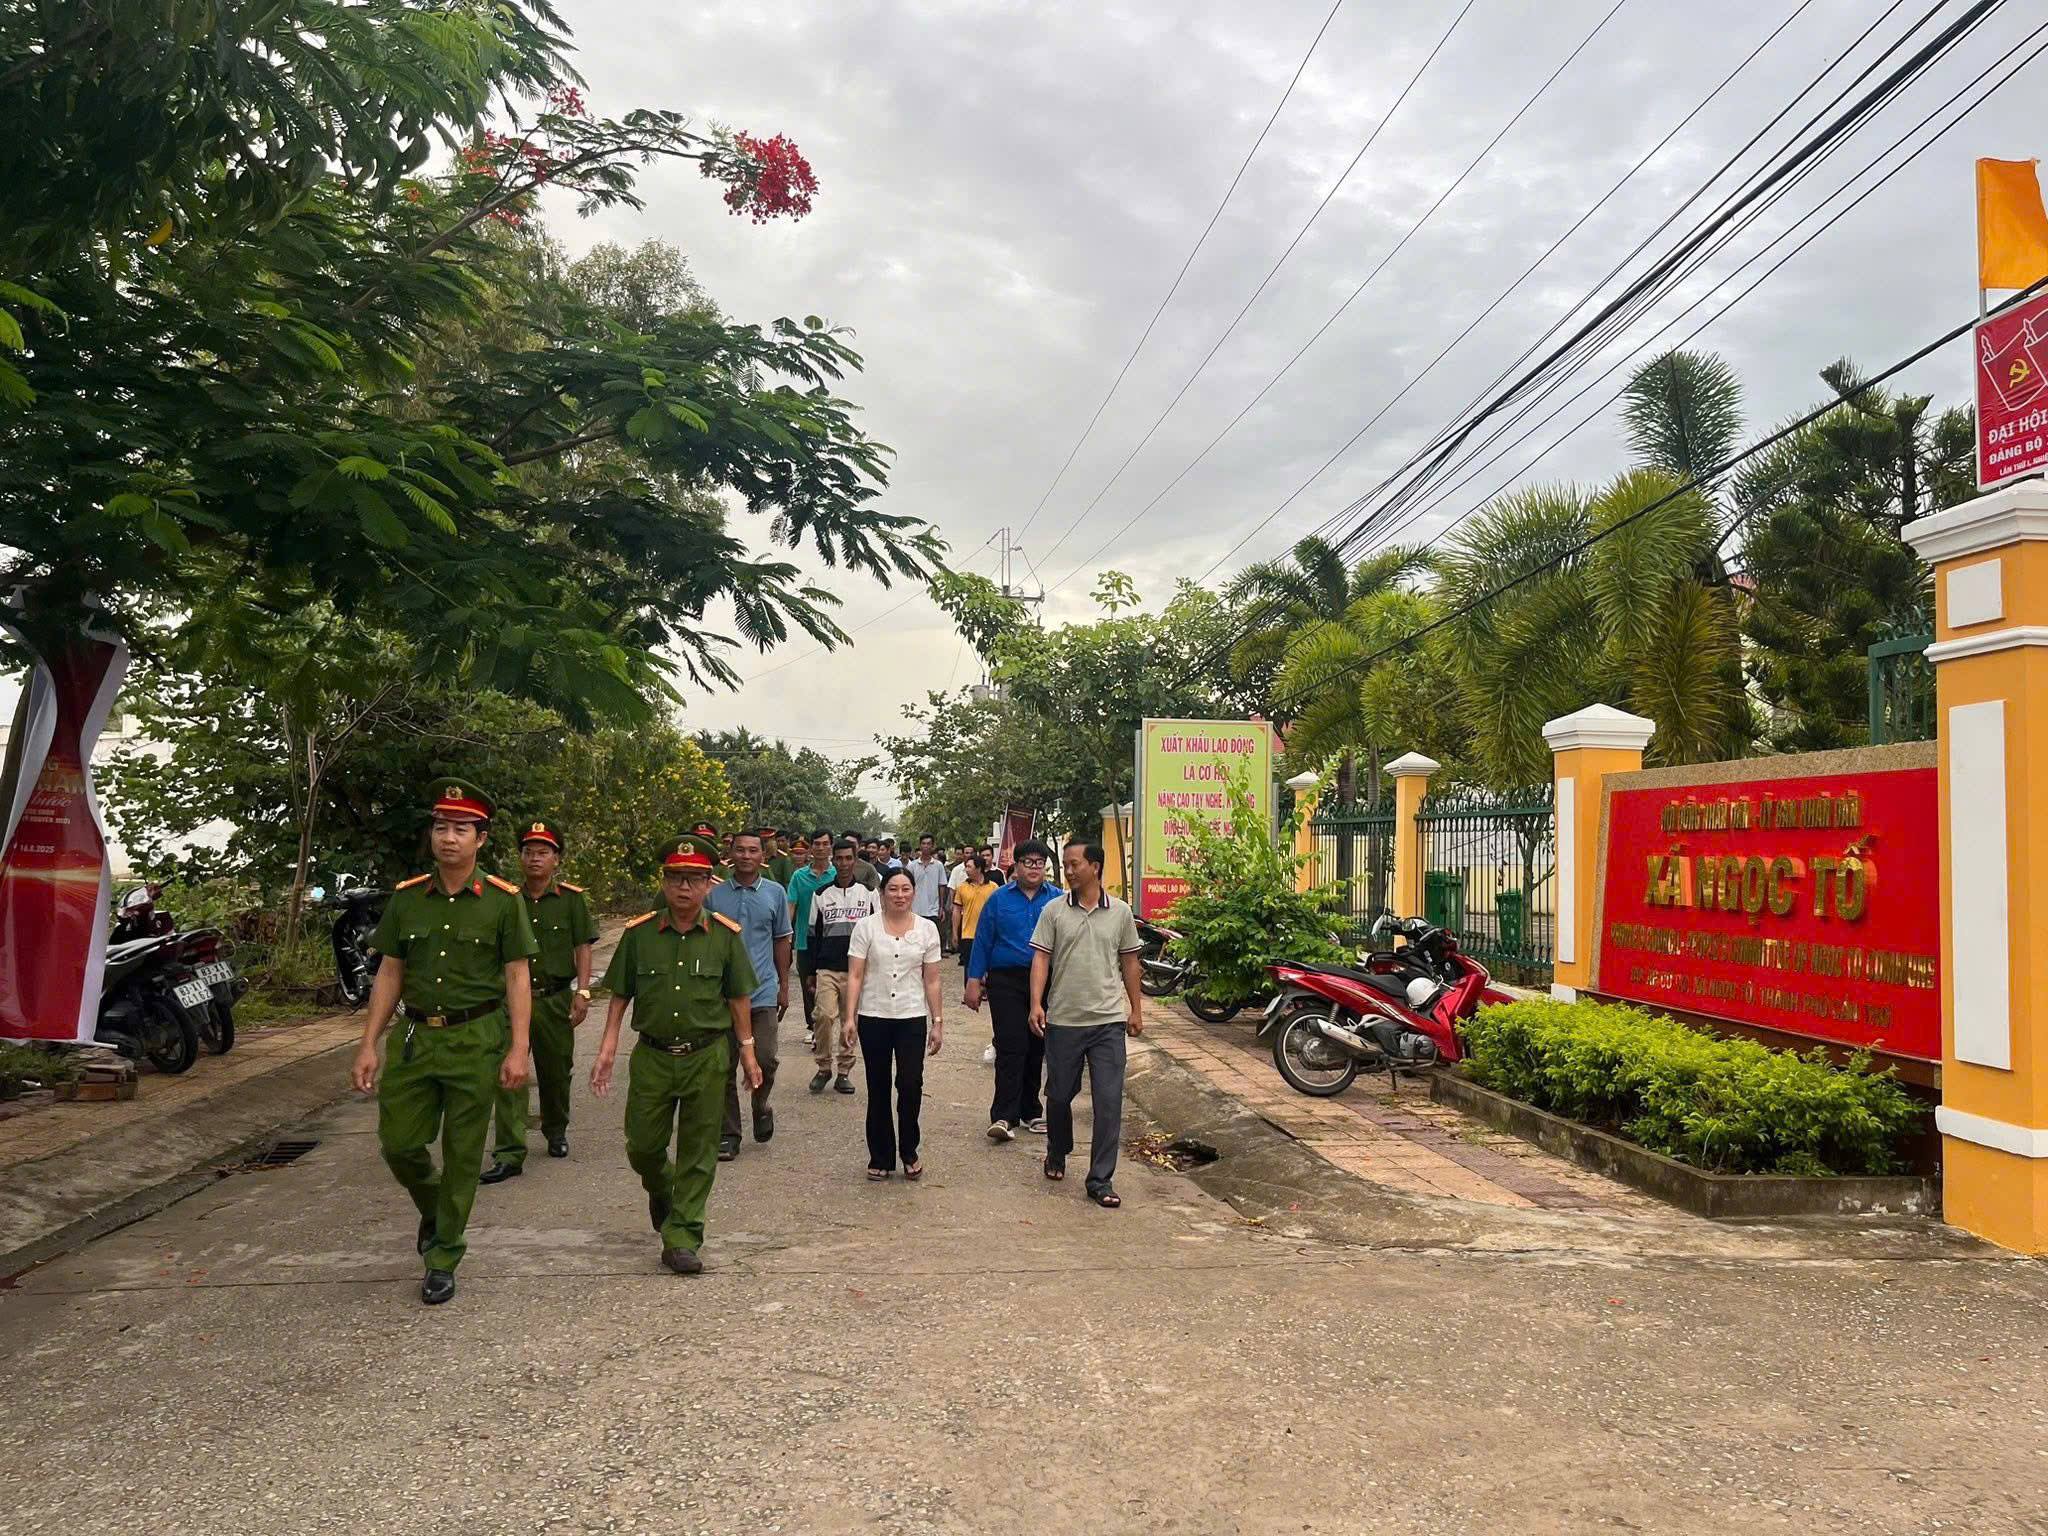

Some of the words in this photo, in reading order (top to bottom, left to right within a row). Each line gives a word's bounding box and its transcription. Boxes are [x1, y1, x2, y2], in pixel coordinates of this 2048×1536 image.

[1988, 422, 2015, 444] ĐẠI
[2018, 408, 2048, 433] HỘI
[1989, 445, 2022, 465] ĐẢNG
[2025, 435, 2043, 452] BỘ
[1160, 731, 1183, 753] XUẤT
[1185, 729, 1209, 753] KHẨU
[1212, 738, 1229, 753] LAO
[1230, 735, 1255, 756] ĐỘNG
[1183, 761, 1195, 780] LÀ
[1177, 793, 1190, 809] CAO
[1191, 793, 1203, 809] TAY
[1167, 884, 1179, 893] LAO
[1646, 843, 1685, 906] XÃ
[1695, 855, 1795, 926] NGỌC
[1809, 833, 1873, 921] TỐ
